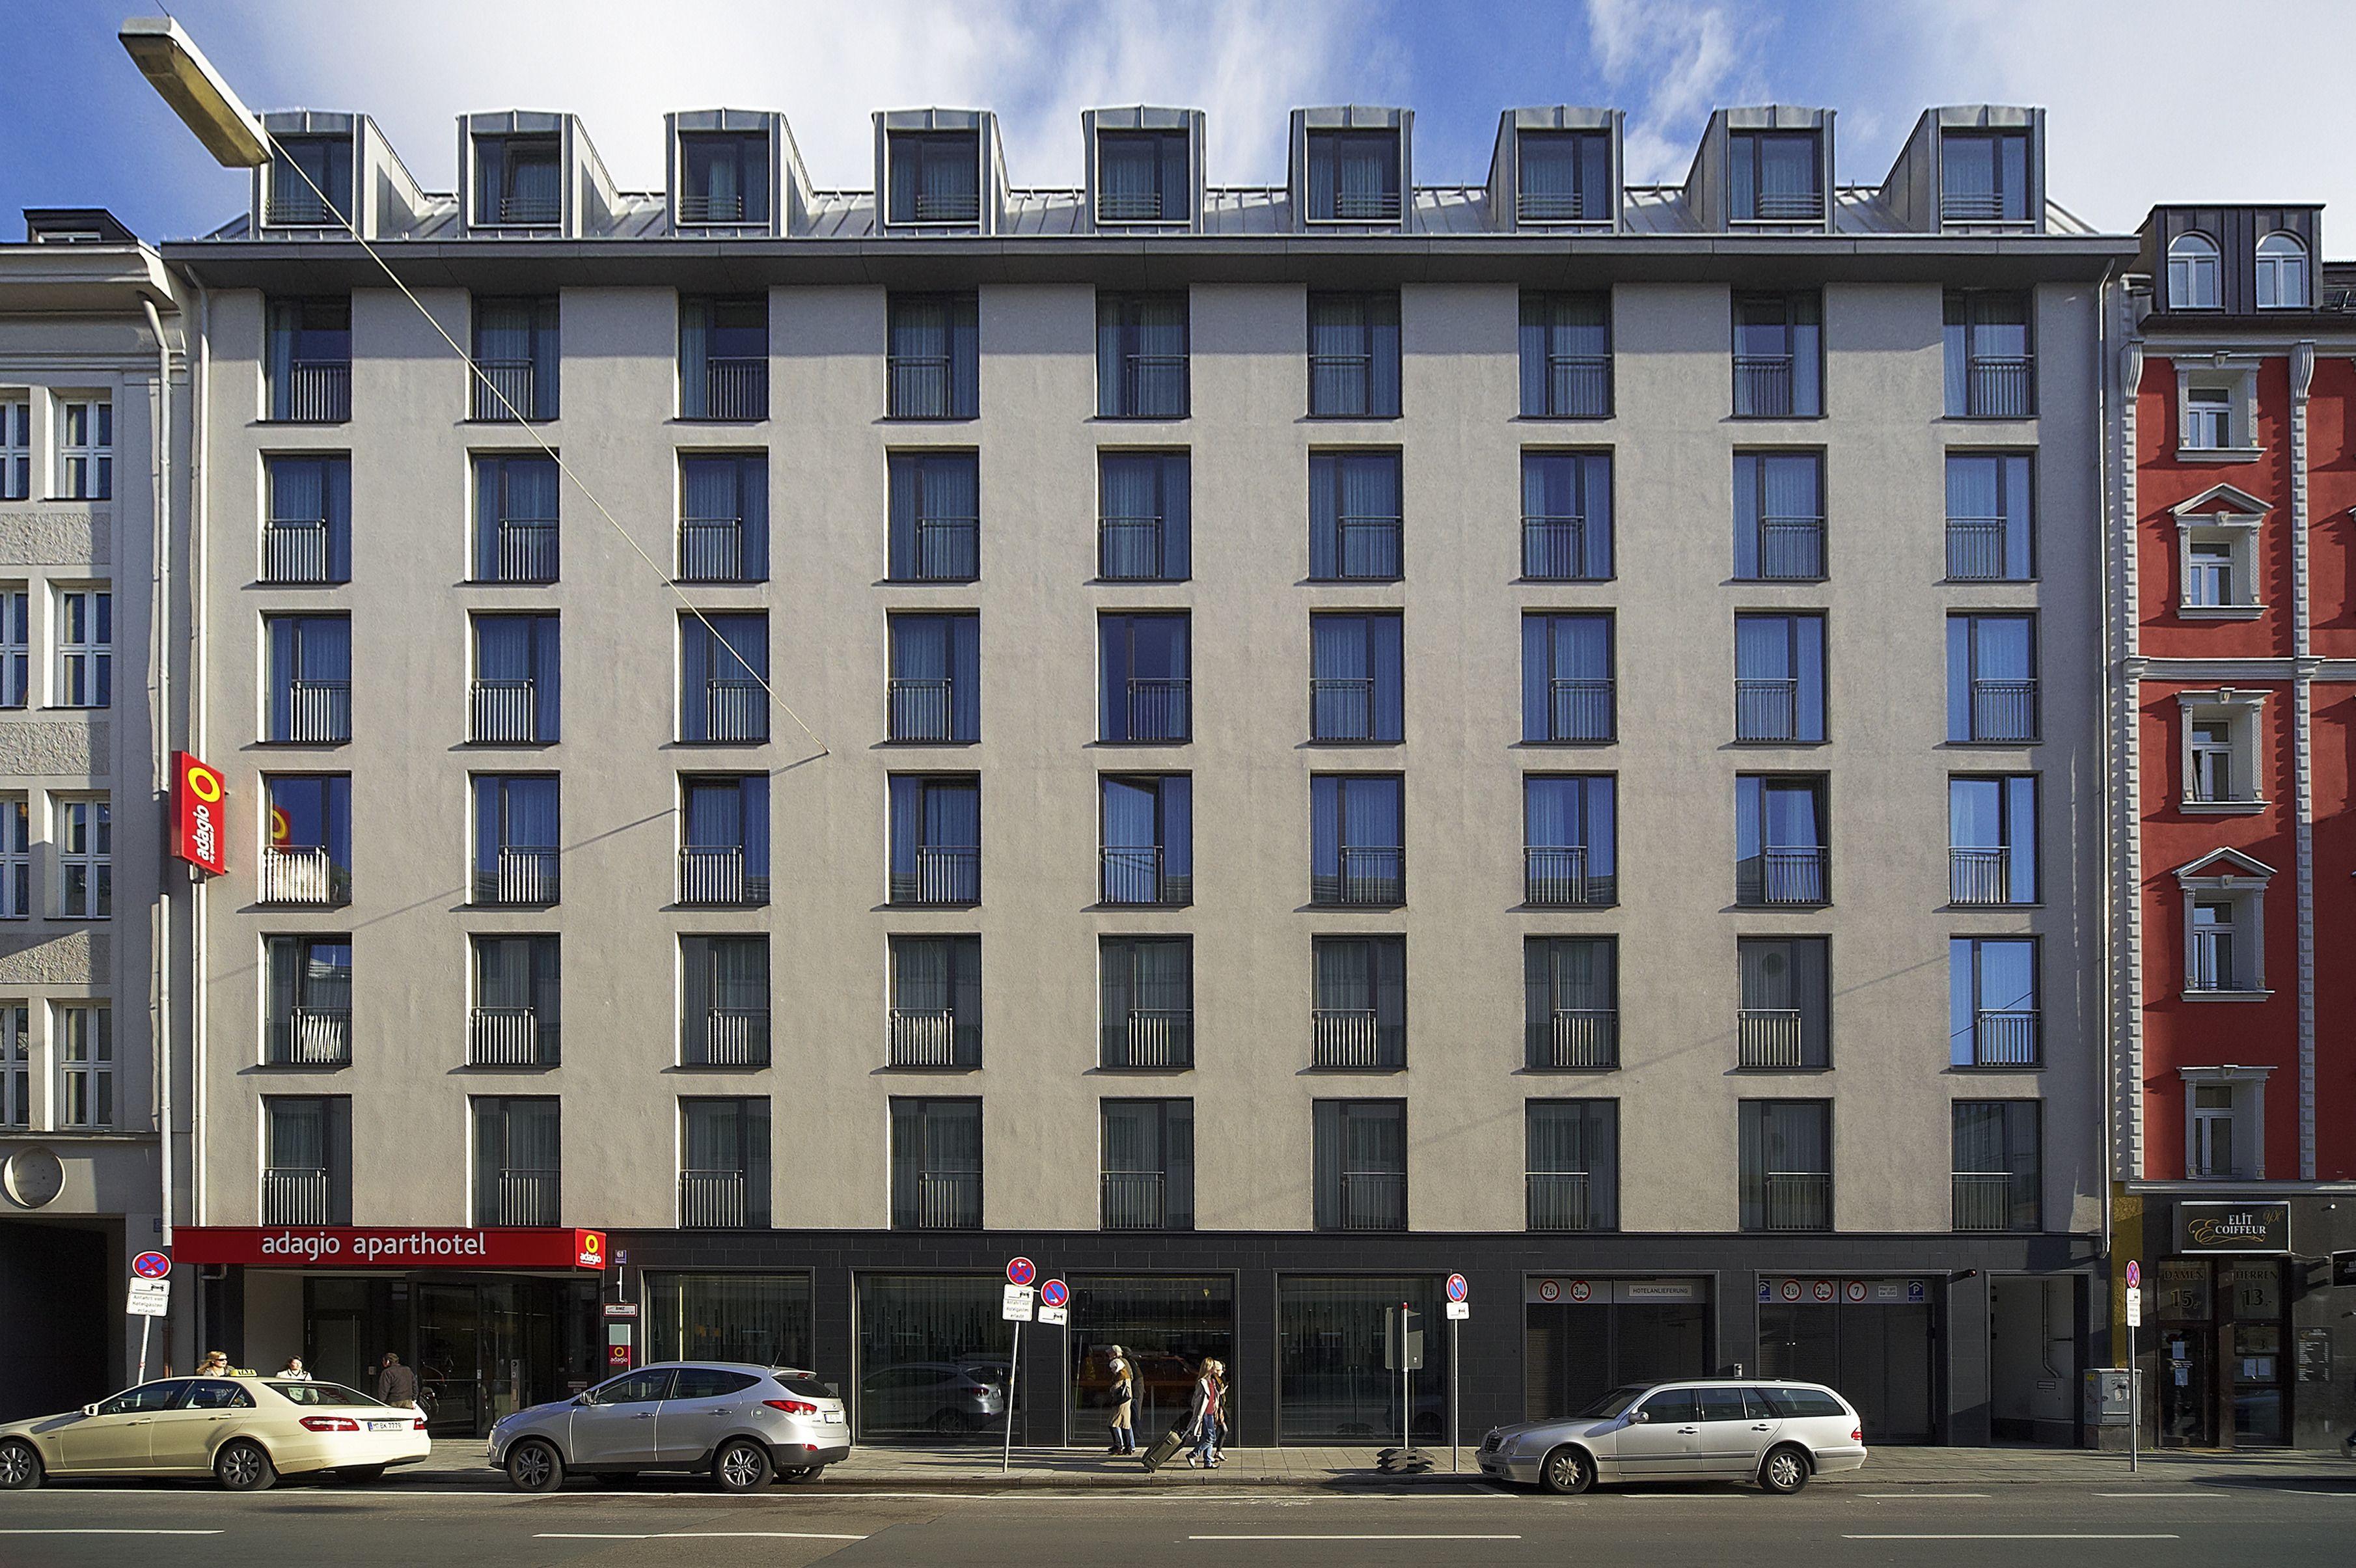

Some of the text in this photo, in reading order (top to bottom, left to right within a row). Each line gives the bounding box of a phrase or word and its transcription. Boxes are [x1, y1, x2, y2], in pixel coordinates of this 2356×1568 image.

[192, 804, 215, 862] adagio
[2215, 1226, 2266, 1234] COIFFEUR
[261, 1230, 486, 1261] adagio aparthotel
[579, 1251, 602, 1263] adagio
[2164, 1269, 2205, 1280] DAMEN
[2235, 1270, 2279, 1280] HERREN
[1854, 1286, 1860, 1296] 7
